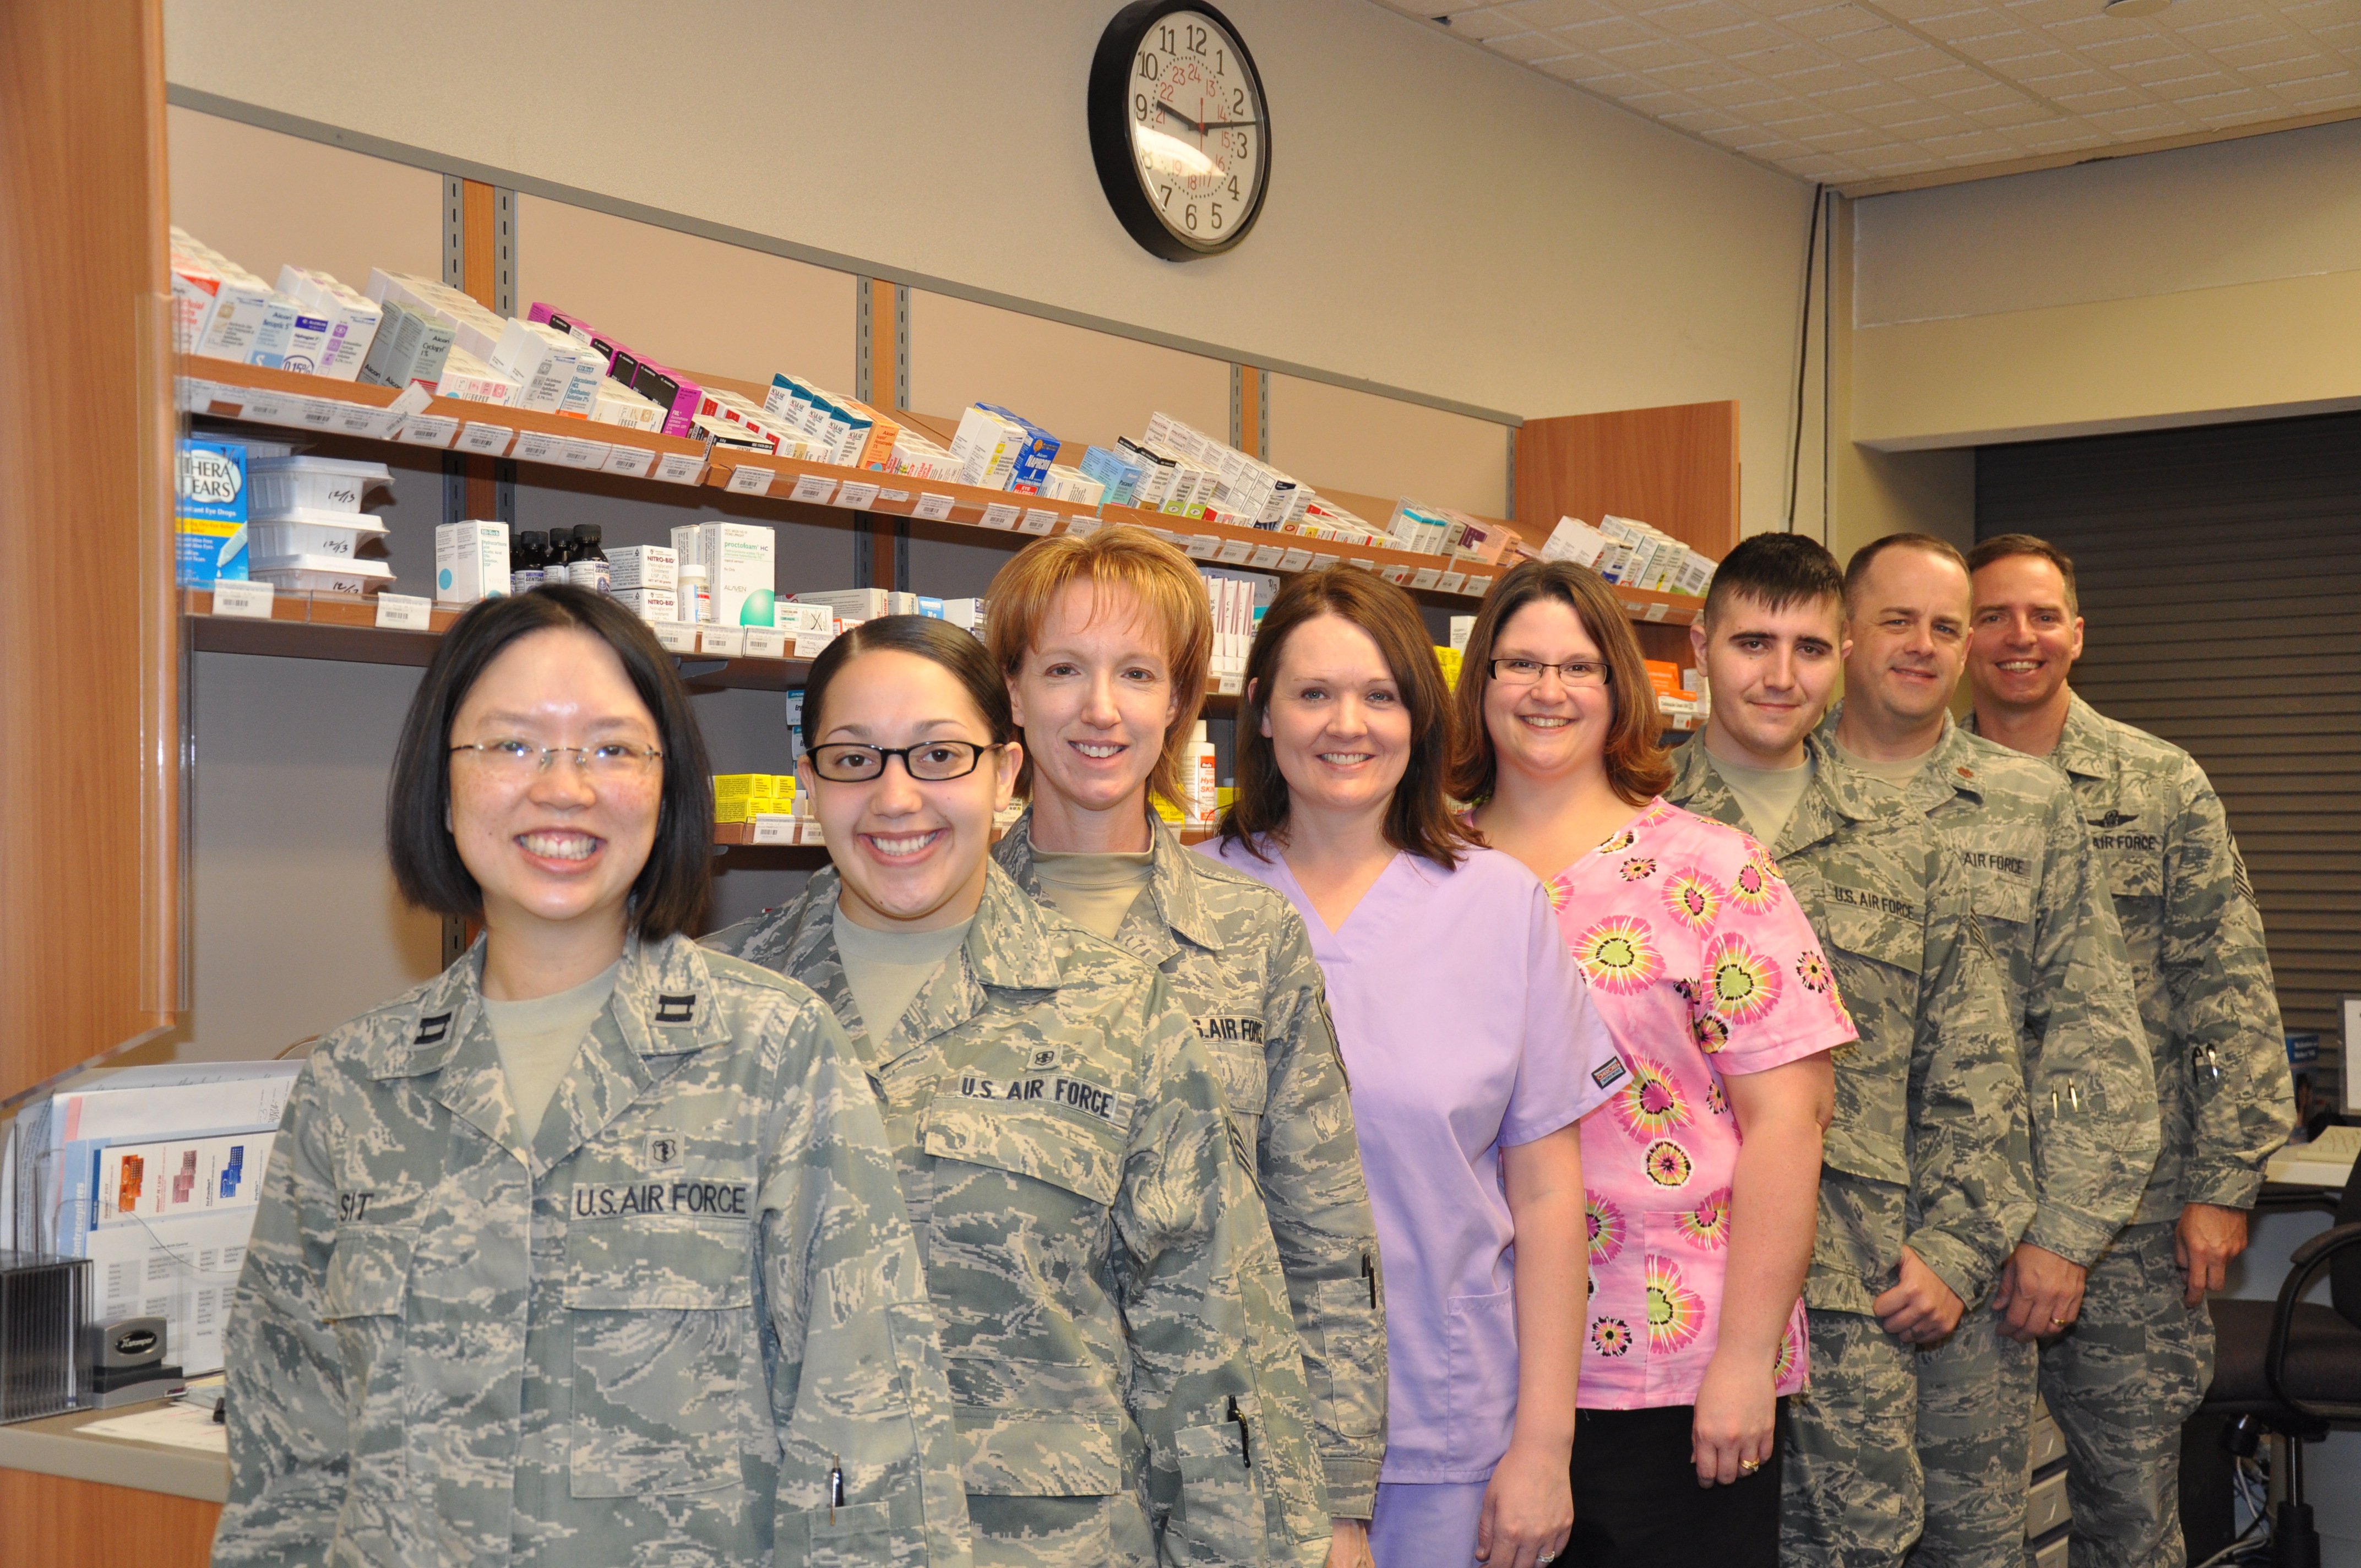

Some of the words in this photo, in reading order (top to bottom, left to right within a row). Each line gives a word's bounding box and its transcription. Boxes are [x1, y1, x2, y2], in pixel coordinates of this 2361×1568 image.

[1159, 25, 1177, 56] 11
[1187, 24, 1207, 56] 12
[1138, 51, 1158, 80] 10
[1216, 50, 1225, 76] 1
[1173, 66, 1185, 85] 23
[1188, 63, 1201, 83] 24
[1160, 82, 1174, 102] 22
[1206, 79, 1215, 97] 13
[1136, 94, 1147, 121] 9
[1233, 88, 1244, 116] 2
[1156, 110, 1165, 124] 21
[1217, 104, 1227, 122] 14
[1222, 130, 1230, 148] 15
[1237, 132, 1247, 159] 3
[1141, 143, 1154, 170] 8
[1216, 154, 1225, 172] 16
[1172, 159, 1182, 177] 19
[1188, 173, 1196, 190] 18
[1228, 175, 1239, 202] 4
[1161, 184, 1172, 212] 7
[1185, 204, 1197, 230] 6
[1211, 202, 1222, 229] 5
[284, 361, 311, 374] 015%
[365, 364, 381, 379] Alcon
[791, 399, 805, 410] ACULAR
[810, 410, 824, 421] ACULAR
[1151, 419, 1168, 430] FALCON
[829, 421, 844, 432] ACULAR
[1172, 429, 1188, 440] FALCON
[704, 435, 713, 456] GENTAK
[1025, 454, 1052, 471] NAPHCON
[1029, 469, 1037, 480] A
[192, 479, 230, 498] EARS
[328, 489, 356, 503] 12/13
[205, 507, 216, 515] Eye
[217, 508, 237, 518] Drops
[323, 540, 349, 553] 12/13
[724, 542, 758, 550] proctofoam
[1200, 777, 1215, 785] Hyd
[2093, 835, 2113, 850] AIR
[2117, 835, 2156, 850] FORCE
[1964, 852, 1987, 868] AIR
[1990, 855, 2023, 874] FORCE
[1834, 886, 1857, 905] U.S.
[1859, 892, 1880, 911] AIR
[1881, 898, 1914, 921] FORCE
[1192, 1019, 1209, 1038] S.
[1210, 1019, 1237, 1039] AIR
[961, 1077, 995, 1099] U.S.
[1007, 1079, 1045, 1100] AIR
[1055, 1079, 1113, 1118] FORCE
[619, 1185, 664, 1214] AIR
[672, 1183, 746, 1214] FORCE
